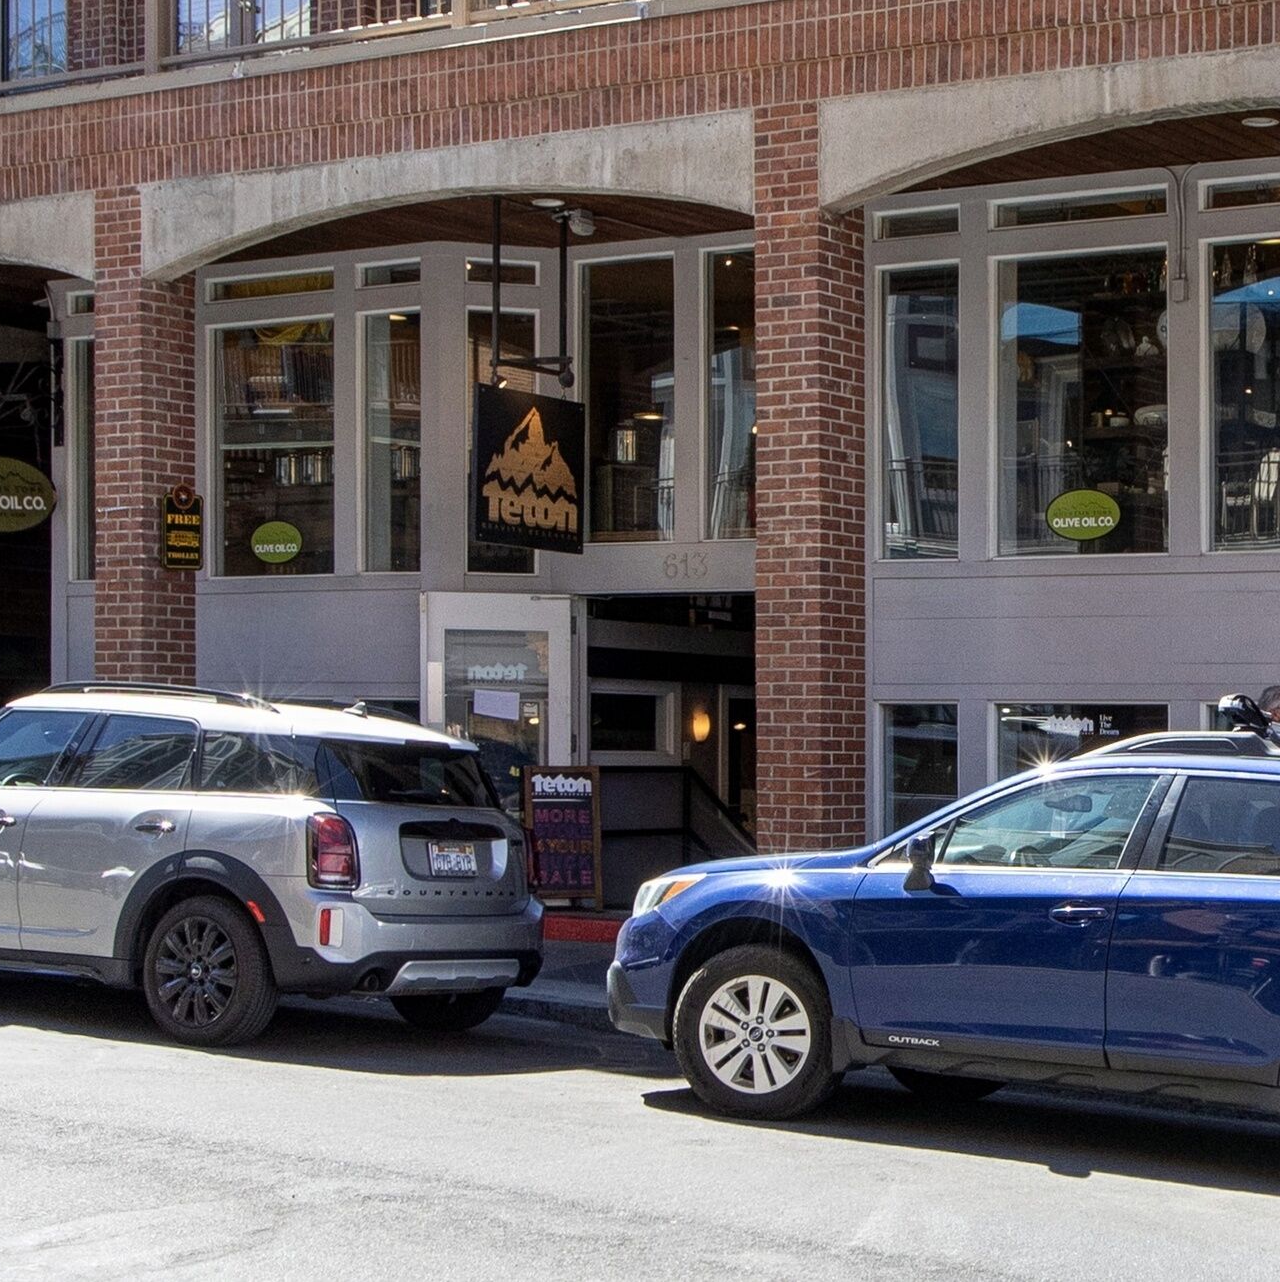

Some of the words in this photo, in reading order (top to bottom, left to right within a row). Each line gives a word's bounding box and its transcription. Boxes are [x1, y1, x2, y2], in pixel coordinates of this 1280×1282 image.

[23, 496, 47, 511] CO.
[167, 514, 200, 525] FREE
[1053, 518, 1080, 528] OLIVE
[1081, 517, 1097, 527] OIL
[1098, 516, 1115, 527] CO.
[255, 544, 274, 554] OLIVE
[275, 543, 286, 553] OIL
[663, 552, 709, 579] 613
[888, 1035, 940, 1046] OUTBACK
